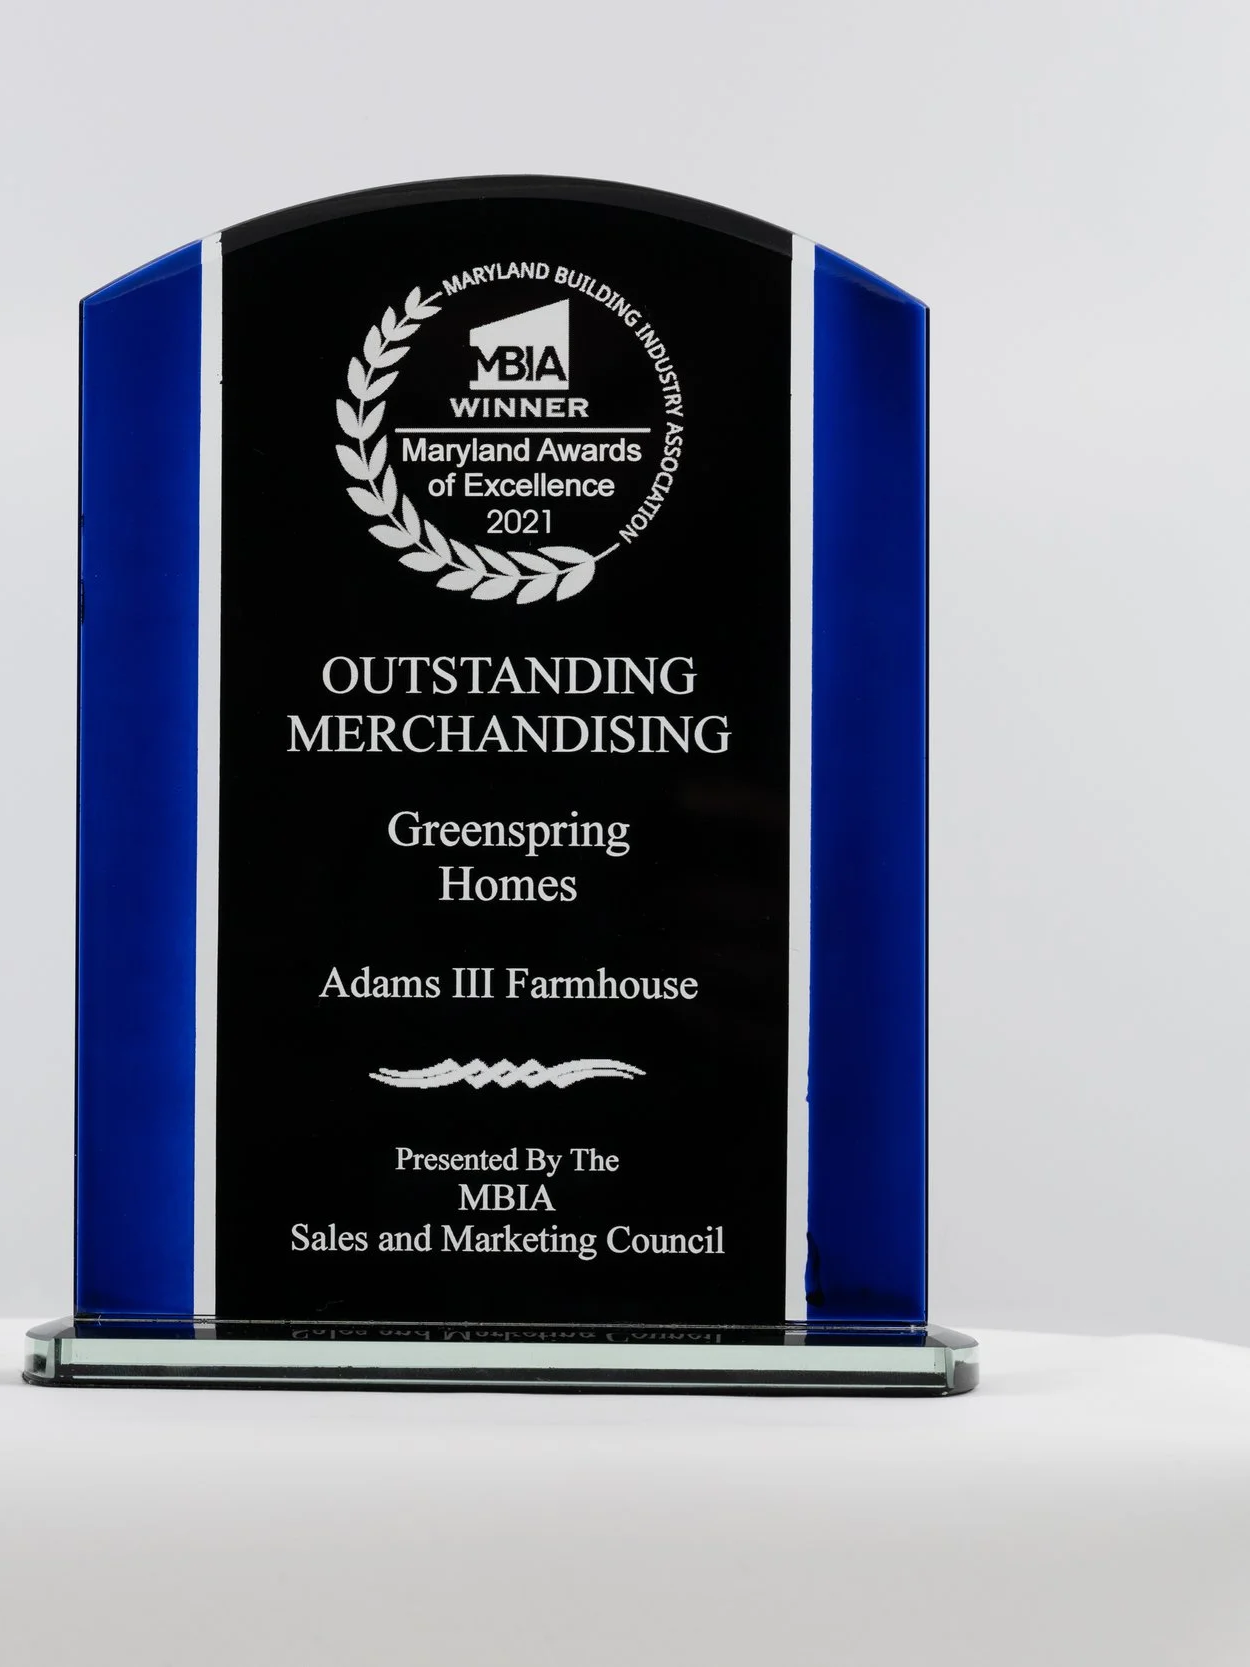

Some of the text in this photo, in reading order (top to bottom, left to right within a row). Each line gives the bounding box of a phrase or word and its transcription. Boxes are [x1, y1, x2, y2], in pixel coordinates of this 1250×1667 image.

[470, 345, 568, 382] MBIA
[442, 262, 683, 543] MARYLAND BUILDING INDUSTRY ASSOCIATION
[450, 398, 589, 417] WINNER
[402, 438, 642, 467] Maryland Awards
[428, 473, 615, 497] of Excellence
[487, 510, 551, 534] 2021
[323, 656, 697, 694] OUTSTANDING
[287, 715, 732, 753] MERCHANDISING
[388, 811, 630, 857] Greenspring
[439, 866, 577, 901] Homes
[319, 966, 698, 999] Adams III Farmhouse
[396, 1147, 619, 1177] Presented By The
[459, 1184, 556, 1211] MBIA
[291, 1223, 725, 1260] Sales and Marketing Council
